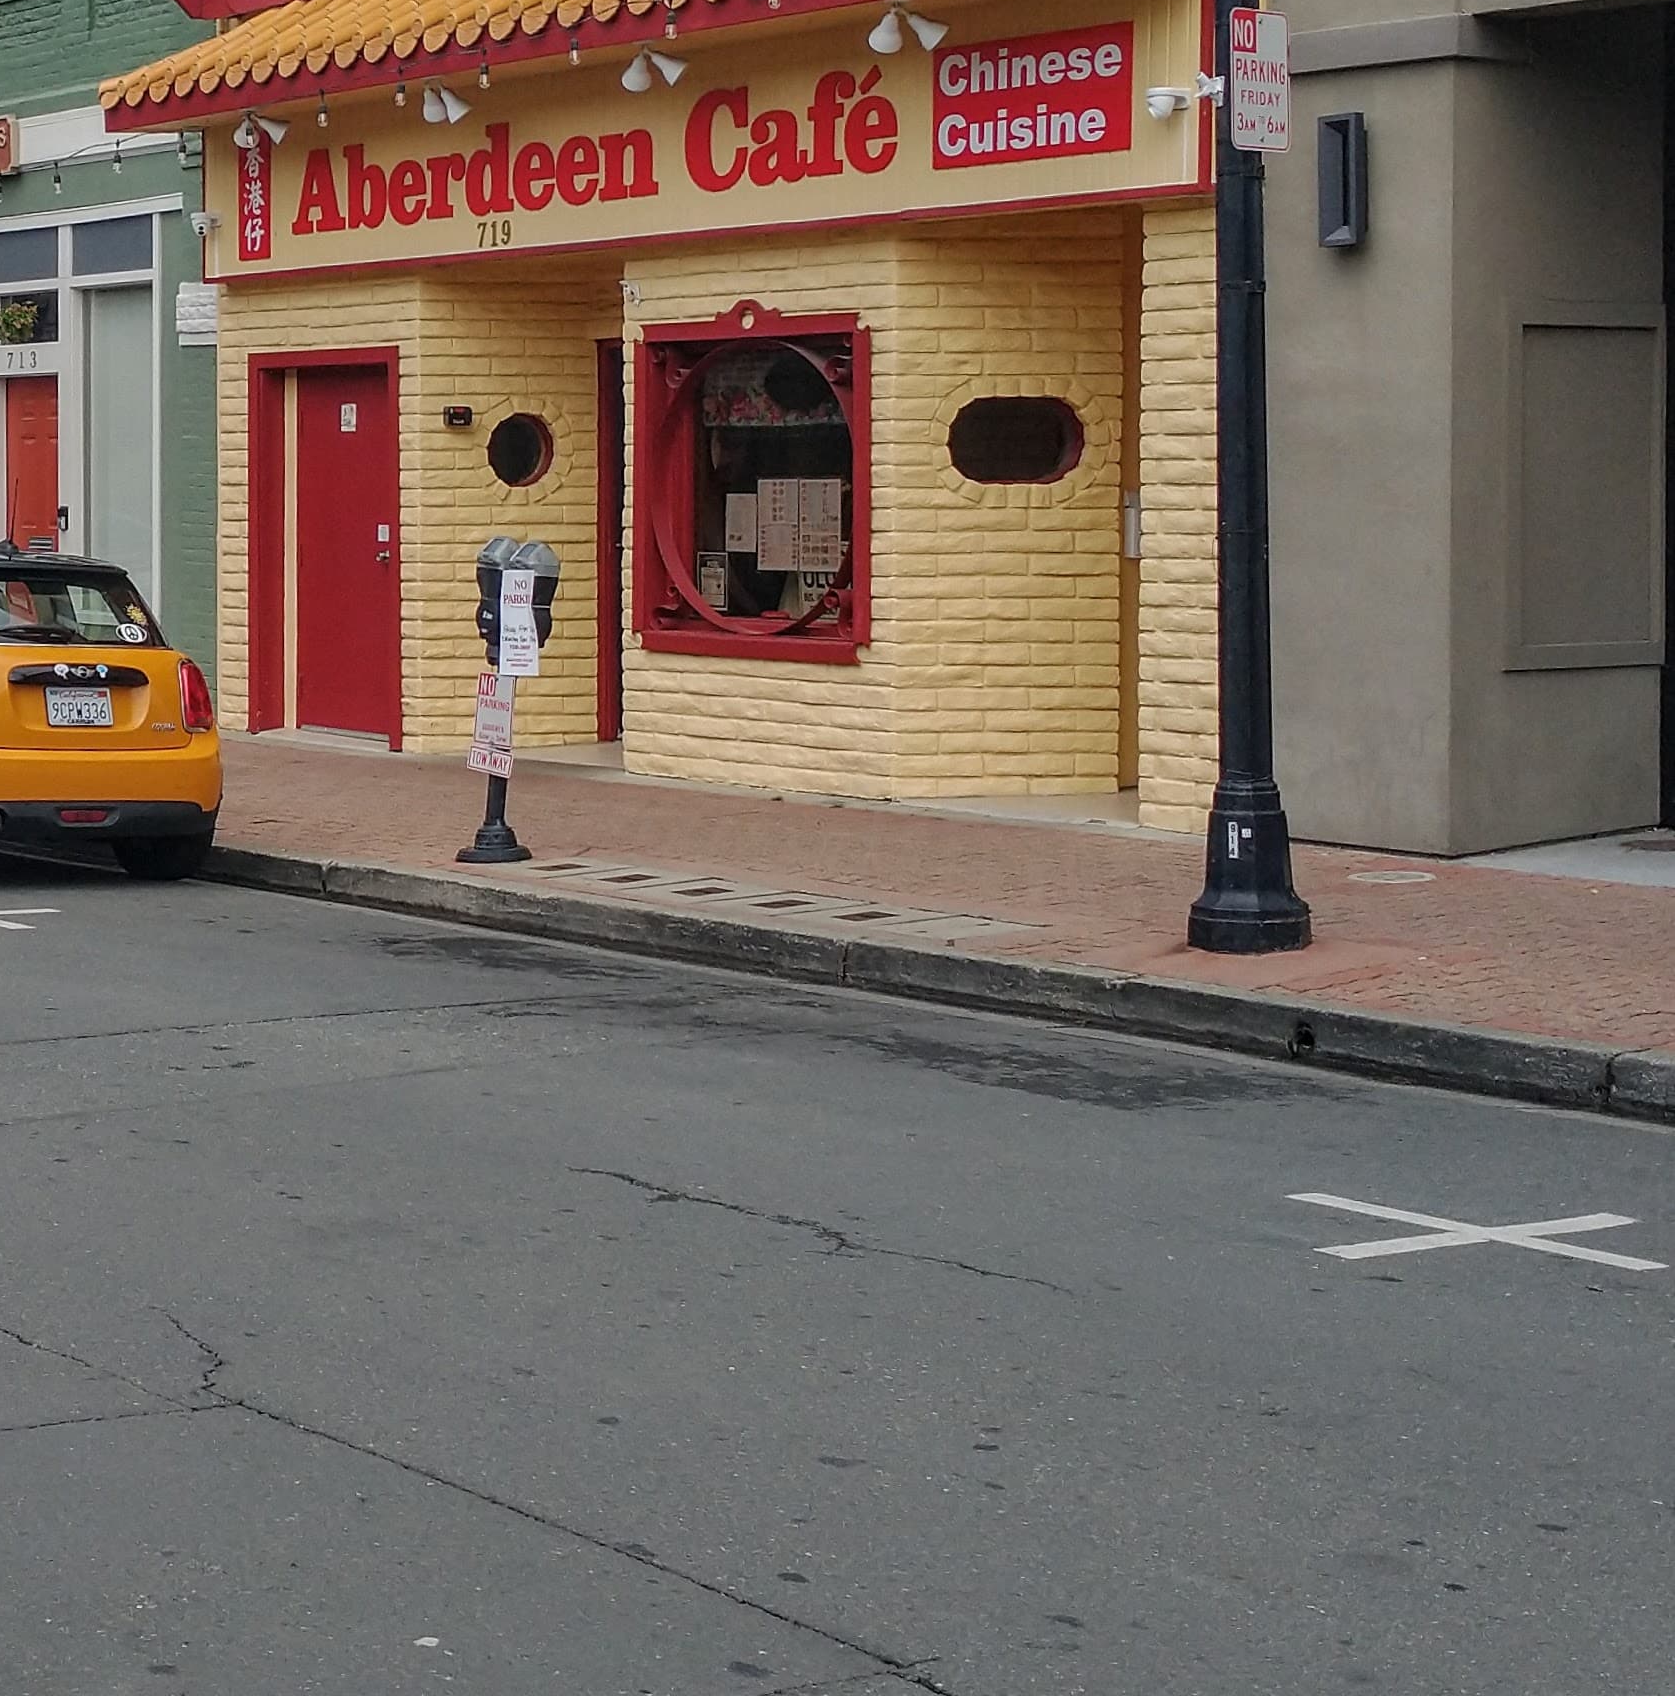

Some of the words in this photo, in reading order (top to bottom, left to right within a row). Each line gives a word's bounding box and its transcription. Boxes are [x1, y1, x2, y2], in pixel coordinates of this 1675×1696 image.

[1234, 18, 1254, 49] NO
[938, 42, 1123, 97] Chinese
[1236, 58, 1285, 86] PARKING
[1240, 89, 1281, 107] FRIDAY
[938, 104, 1106, 157] Cuisine
[1237, 112, 1256, 132] 3AM
[1267, 116, 1286, 135] 6AM
[291, 121, 659, 236] Aberdeen
[684, 65, 899, 193] Café
[243, 147, 265, 252] 香港仔
[477, 219, 512, 249] 719
[7, 350, 37, 369] 713
[514, 579, 527, 591] NO
[480, 674, 495, 696] NO
[52, 701, 107, 720] 9CPW336
[479, 698, 510, 712] PARKING
[472, 750, 488, 766] TOW
